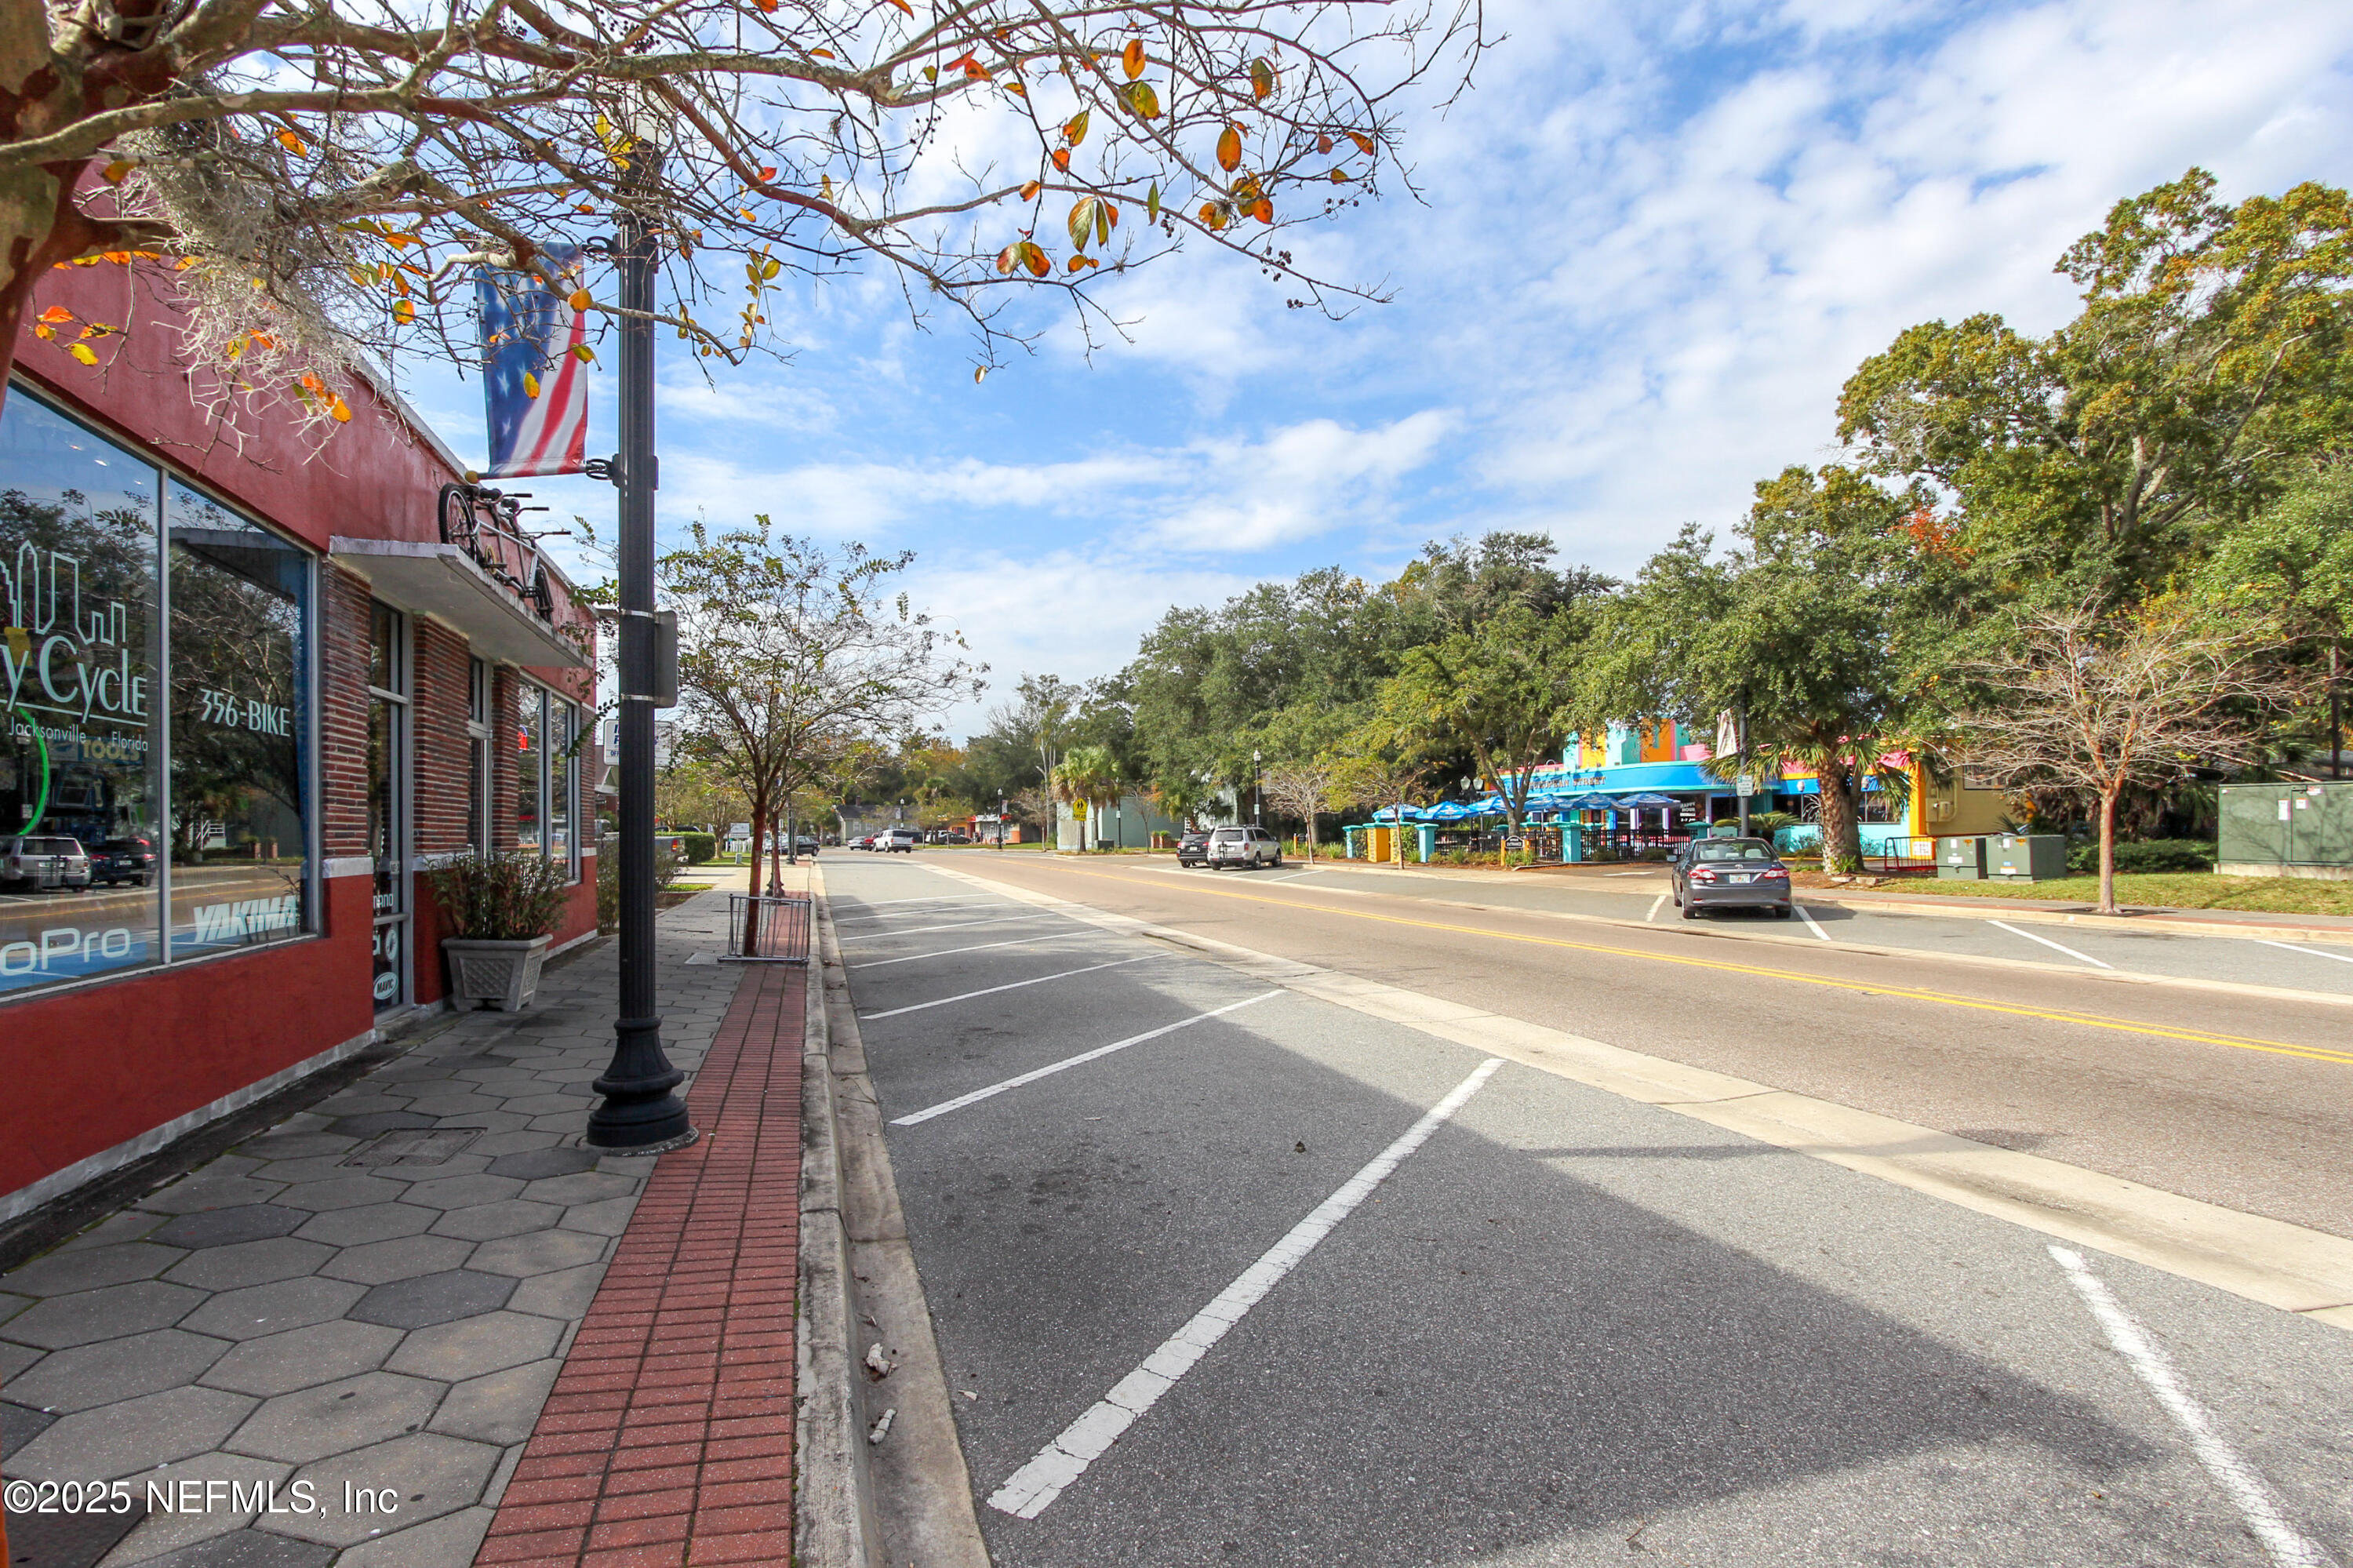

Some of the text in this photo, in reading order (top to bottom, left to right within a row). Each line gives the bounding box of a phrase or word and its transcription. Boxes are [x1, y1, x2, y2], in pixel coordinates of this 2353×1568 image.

[199, 687, 291, 737] 356-BIKE
[9, 716, 148, 751] Jacksonville Florida
[1573, 777, 1606, 787] STREET
[194, 896, 296, 944] YAKIMA
[376, 980, 394, 994] MAVIC
